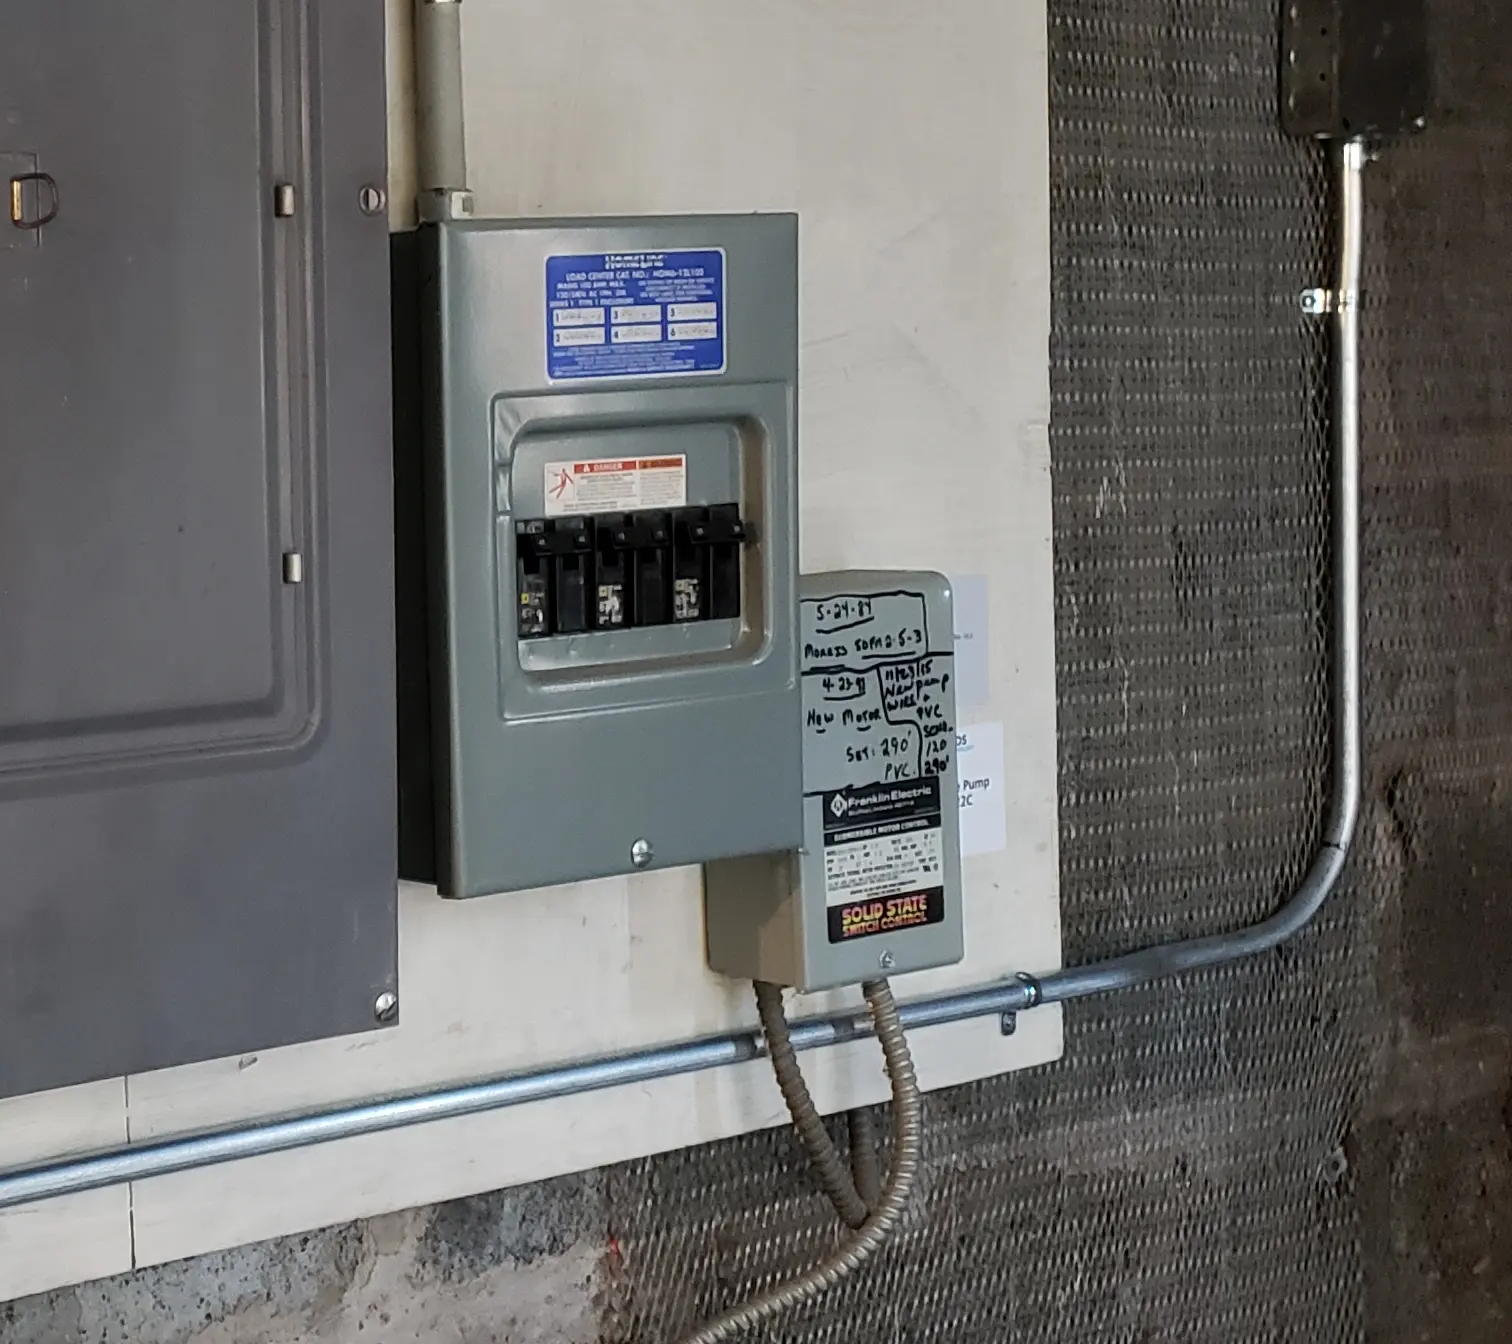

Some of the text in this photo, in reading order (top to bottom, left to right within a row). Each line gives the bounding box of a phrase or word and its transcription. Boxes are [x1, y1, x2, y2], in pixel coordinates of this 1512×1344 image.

[963, 777, 991, 791] Pump
[841, 893, 928, 926] SOLID STATE
[842, 910, 928, 937] SWITCH CONTROL
